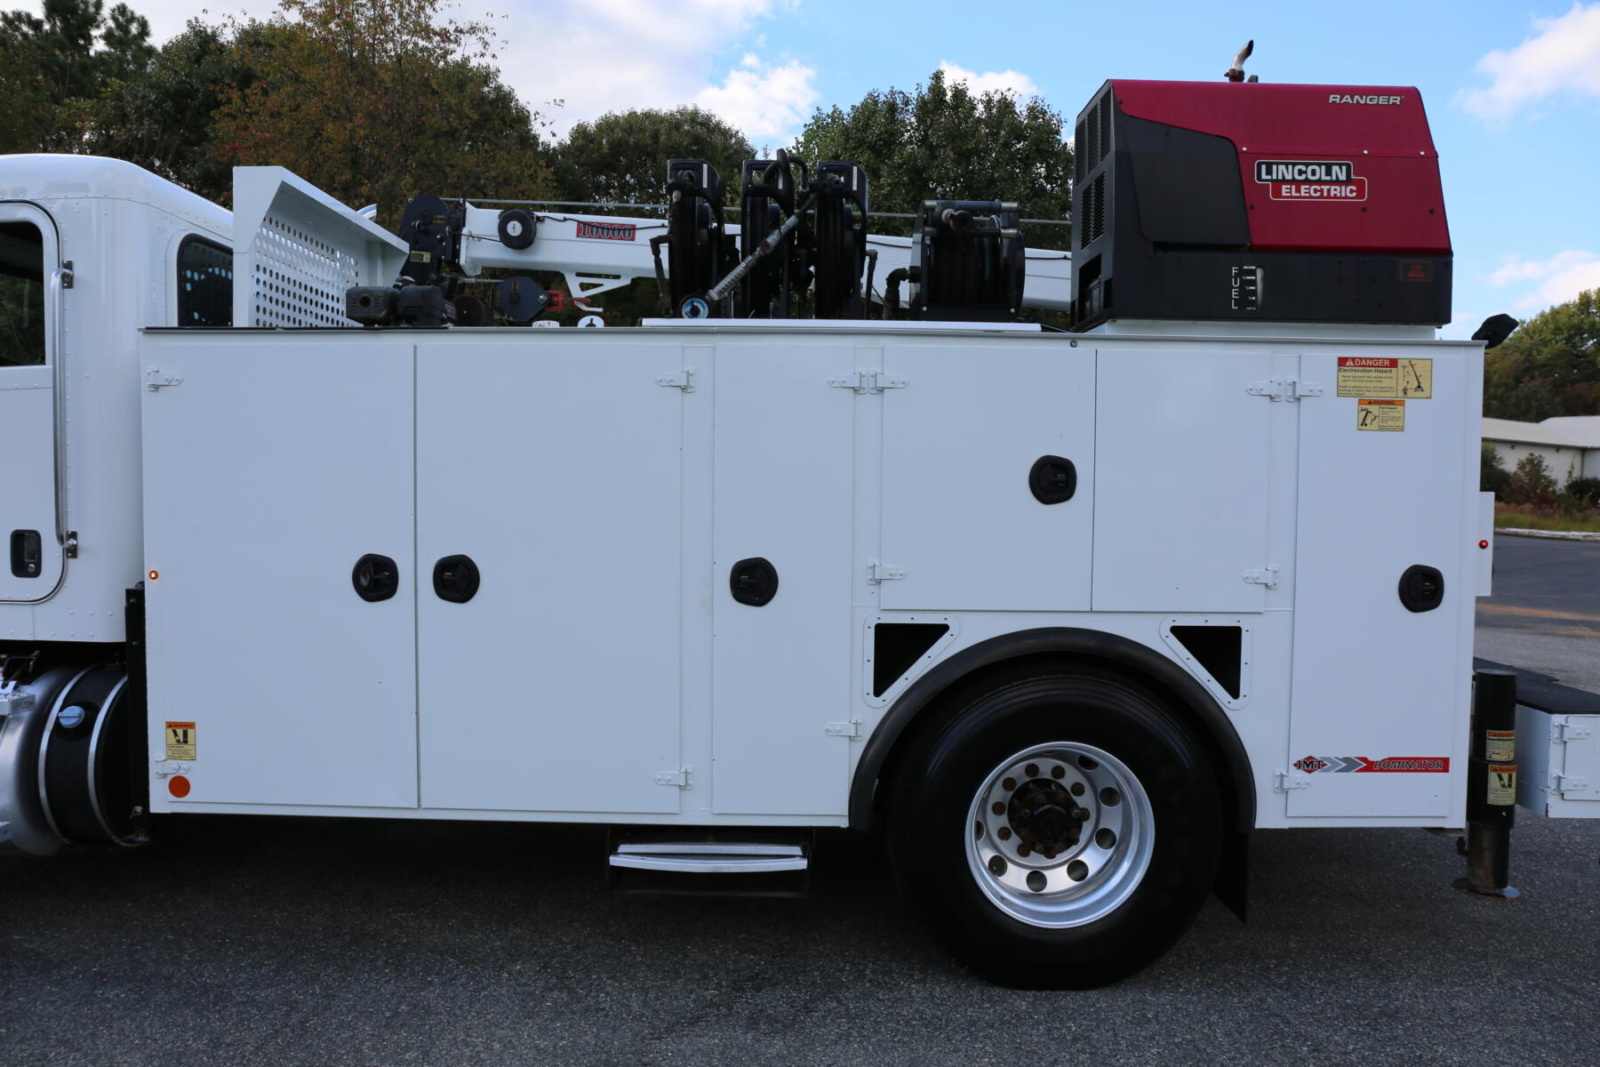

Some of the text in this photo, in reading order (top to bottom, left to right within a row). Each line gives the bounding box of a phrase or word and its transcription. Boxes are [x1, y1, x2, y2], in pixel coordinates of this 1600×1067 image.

[1328, 94, 1401, 105] RANGER
[1260, 164, 1347, 181] LINCOLN
[1281, 185, 1358, 197] ELECTRIC
[580, 223, 632, 239] 10000
[1231, 266, 1240, 310] FUEL
[1354, 358, 1390, 366] DANGER
[1296, 760, 1444, 770] IMT DOMINATOR
